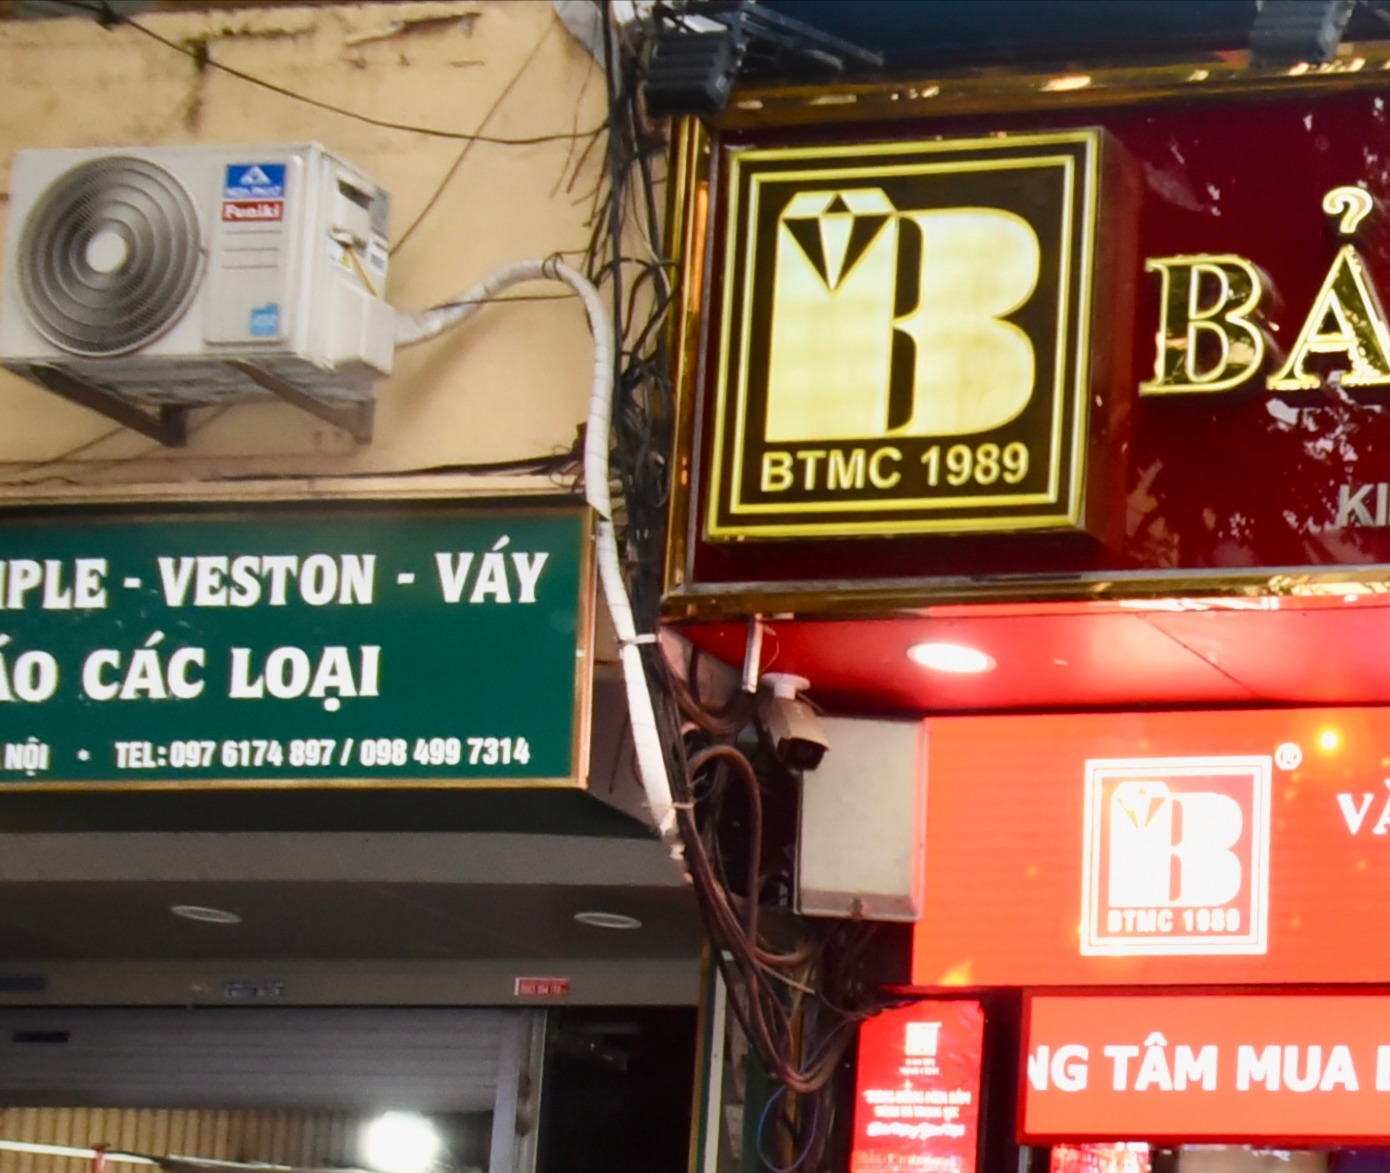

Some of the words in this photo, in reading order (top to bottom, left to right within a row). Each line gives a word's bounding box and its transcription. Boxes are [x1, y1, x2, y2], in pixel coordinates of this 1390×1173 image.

[761, 446, 902, 492] BTMC
[920, 442, 1029, 486] 1989
[0, 558, 108, 609] PLE
[157, 553, 377, 608] VESTON
[434, 535, 549, 603] VÁY
[82, 630, 206, 701] CÁC
[229, 645, 382, 712] LOẠI
[4, 736, 49, 776] NỘI
[221, 739, 284, 768] 6174
[289, 738, 336, 767] 897
[360, 738, 408, 767] 098
[413, 737, 461, 766] 499
[467, 736, 530, 766] 7314
[1107, 908, 1174, 934] BTMC
[1104, 1032, 1218, 1092] TÂM
[1236, 1045, 1360, 1092] MUA
